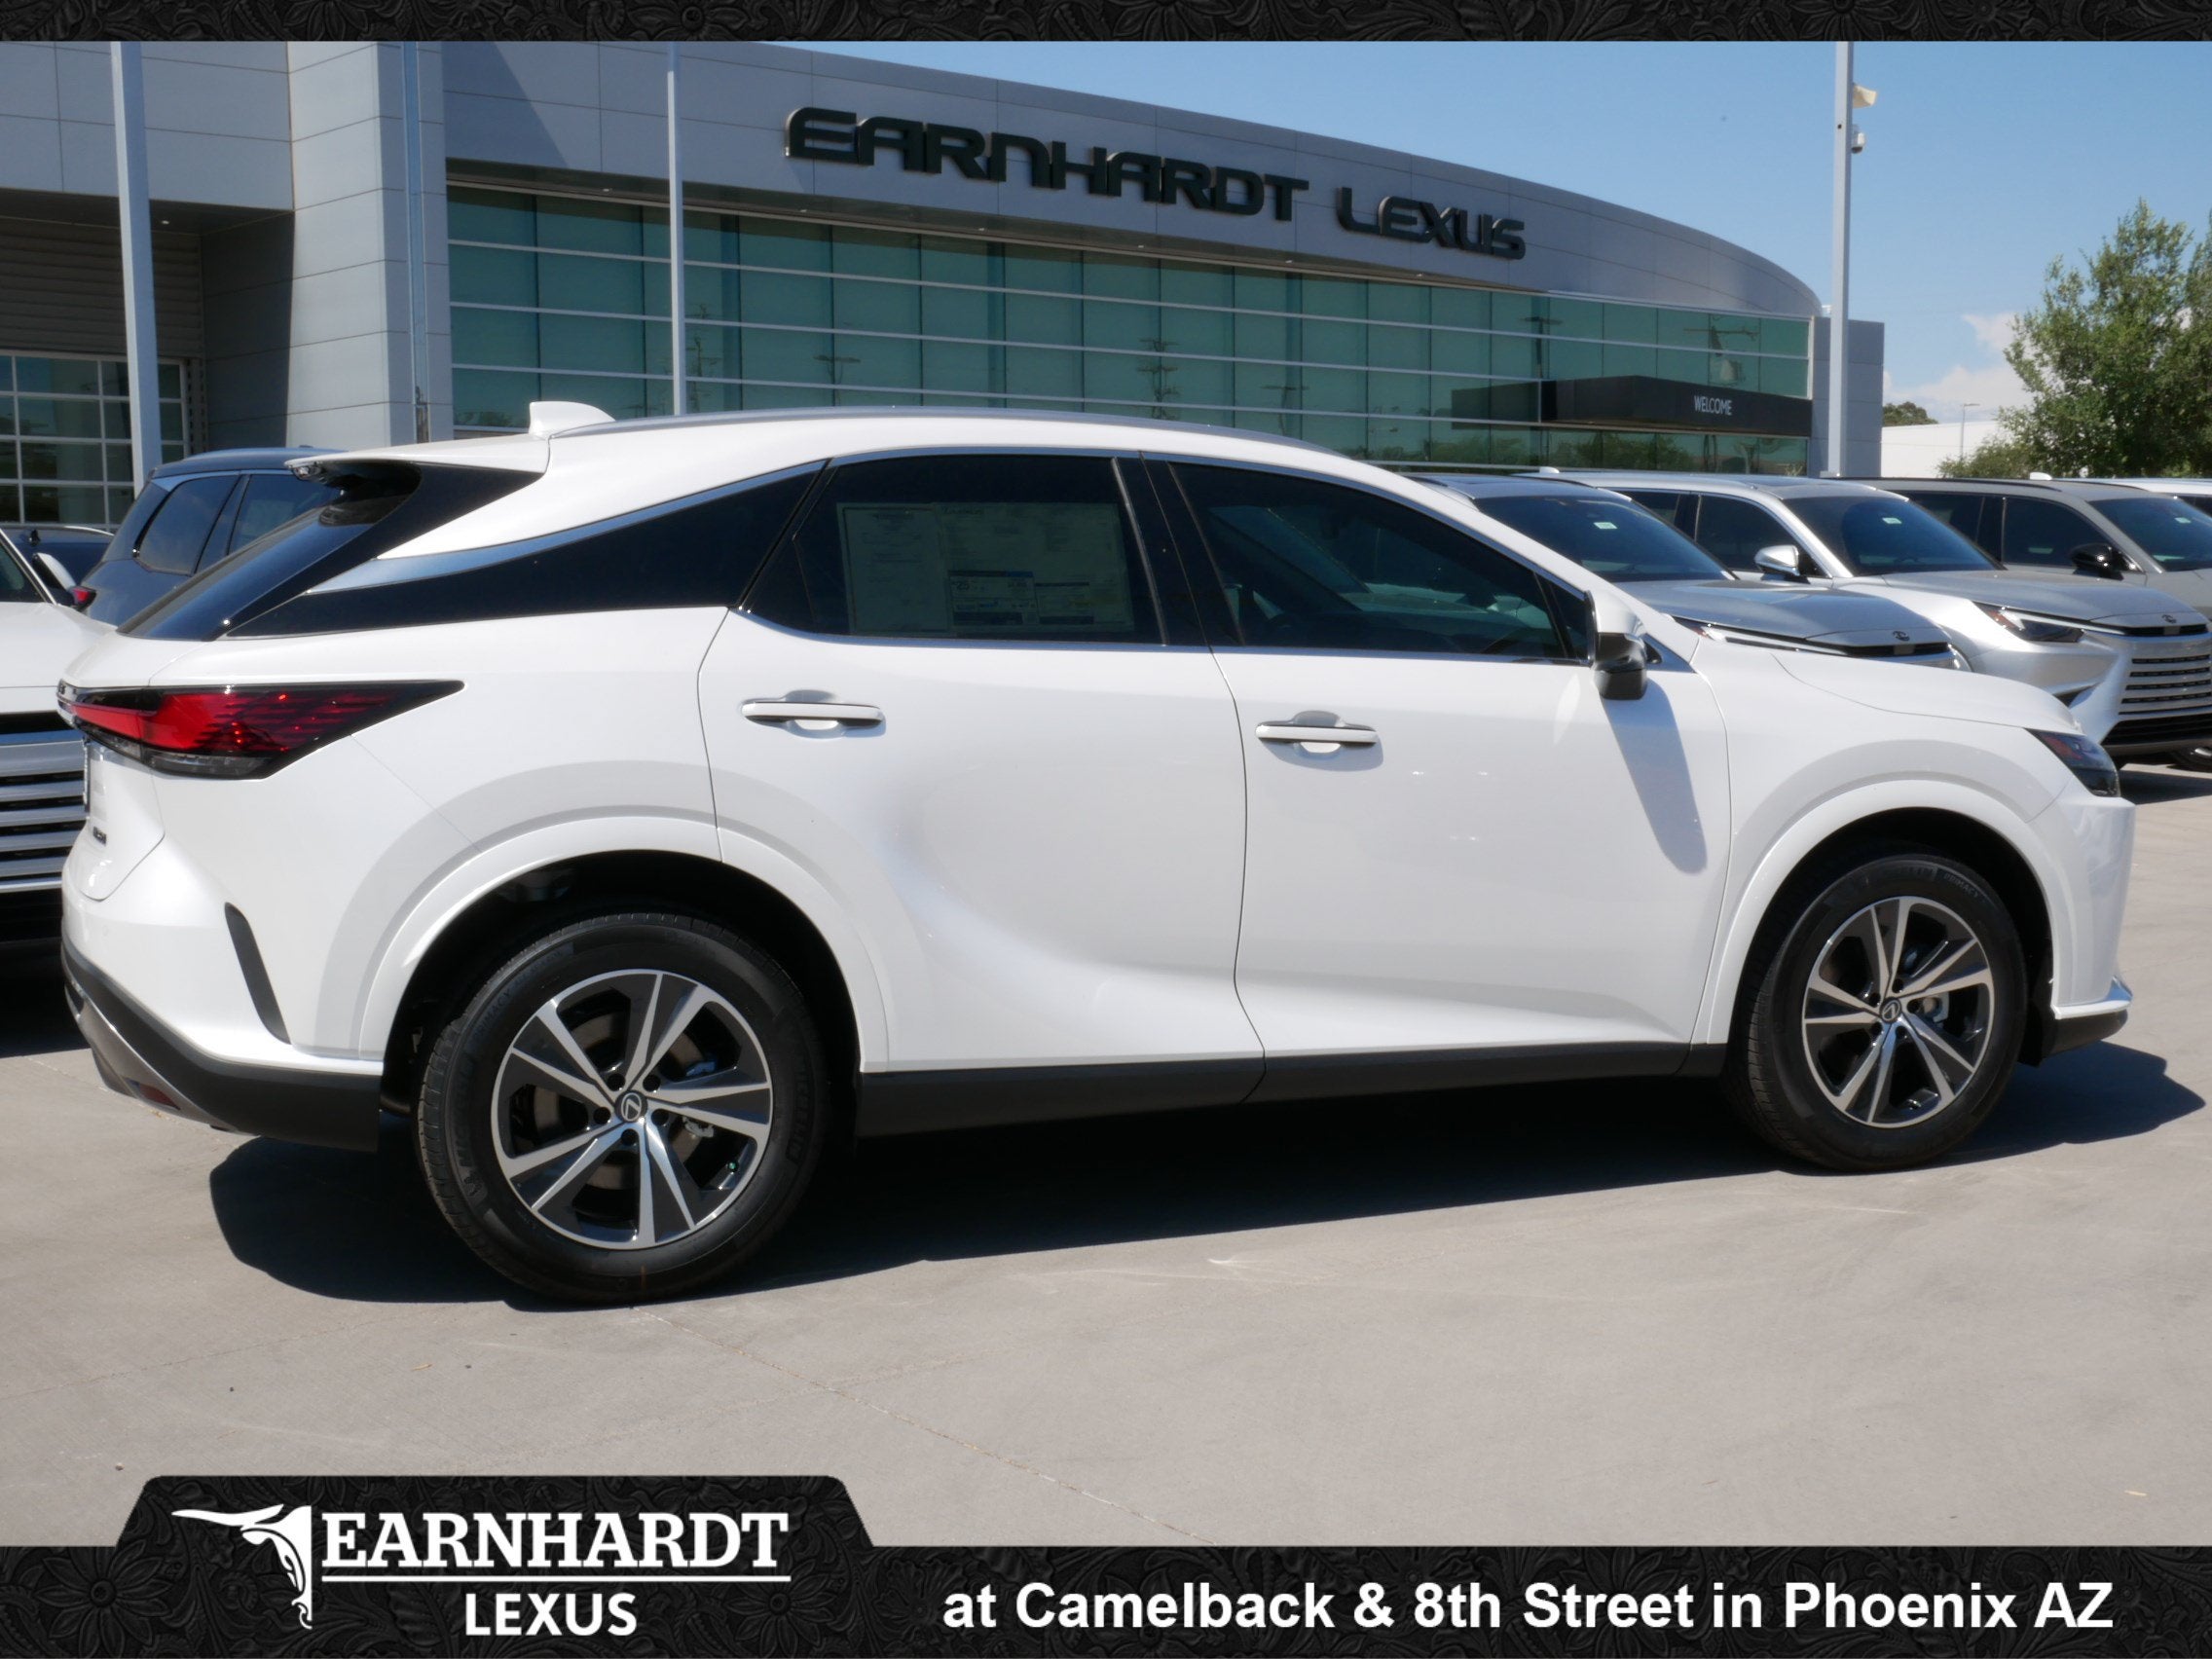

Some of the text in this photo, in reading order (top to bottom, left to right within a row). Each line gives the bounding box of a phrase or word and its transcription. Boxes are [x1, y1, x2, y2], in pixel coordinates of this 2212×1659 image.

[785, 106, 1526, 260] EARNHARDT LEXUS
[1694, 395, 1732, 416] WELCOME
